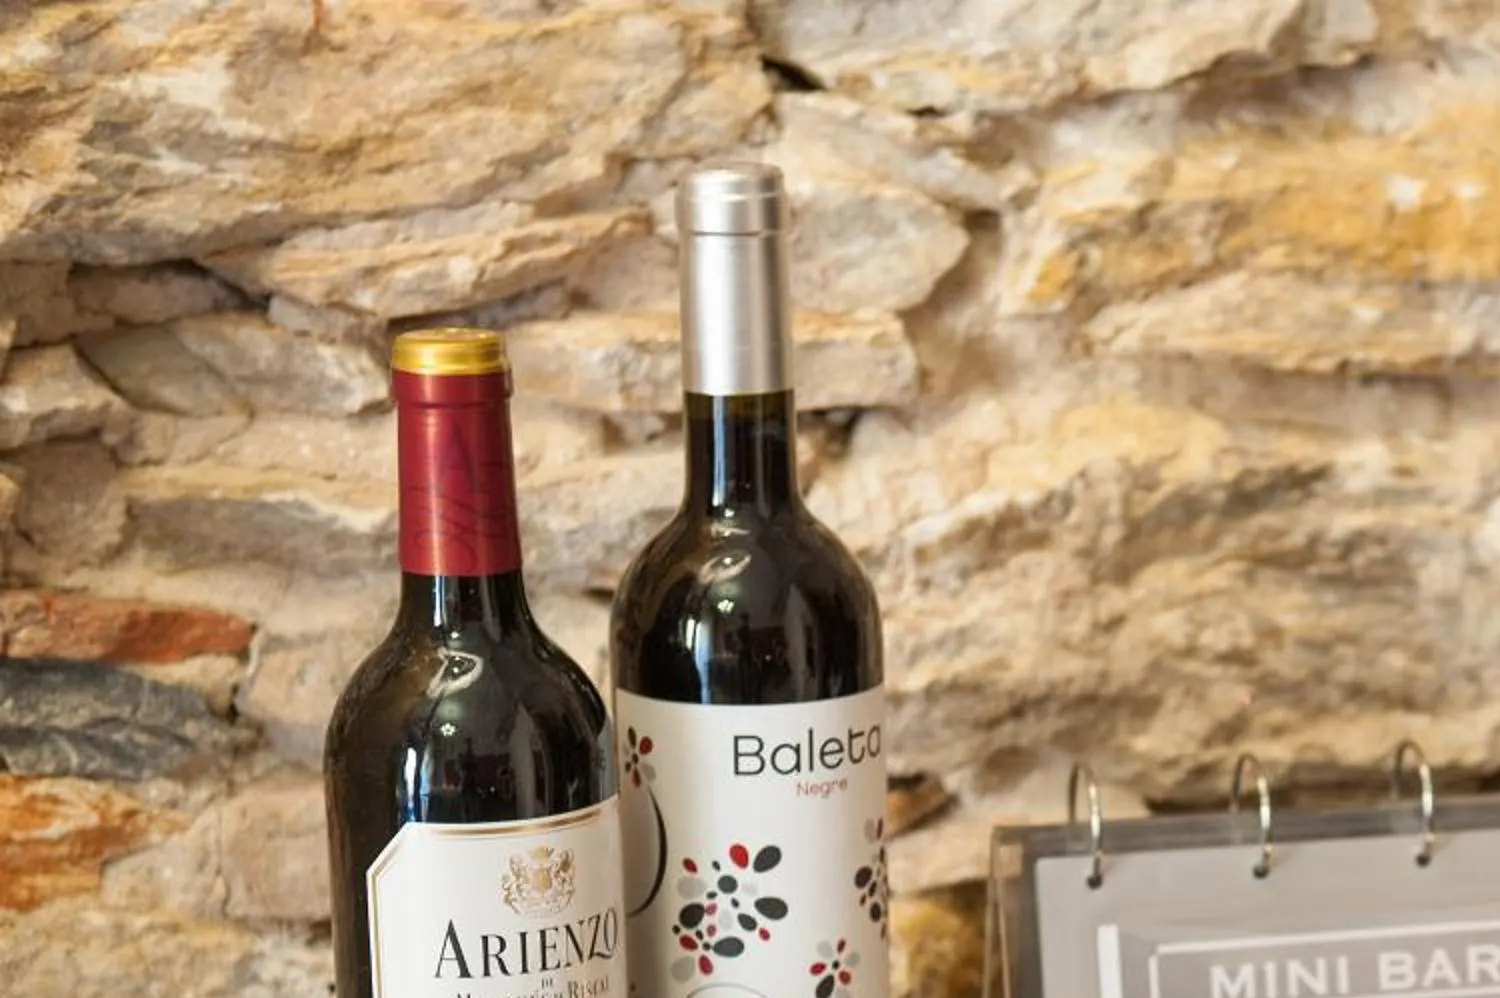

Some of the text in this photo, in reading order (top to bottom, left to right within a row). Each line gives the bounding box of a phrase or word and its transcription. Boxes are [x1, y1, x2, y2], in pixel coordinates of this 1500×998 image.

[733, 724, 882, 776] Baleta
[796, 777, 848, 799] Negre
[434, 907, 619, 978] ARIENZO
